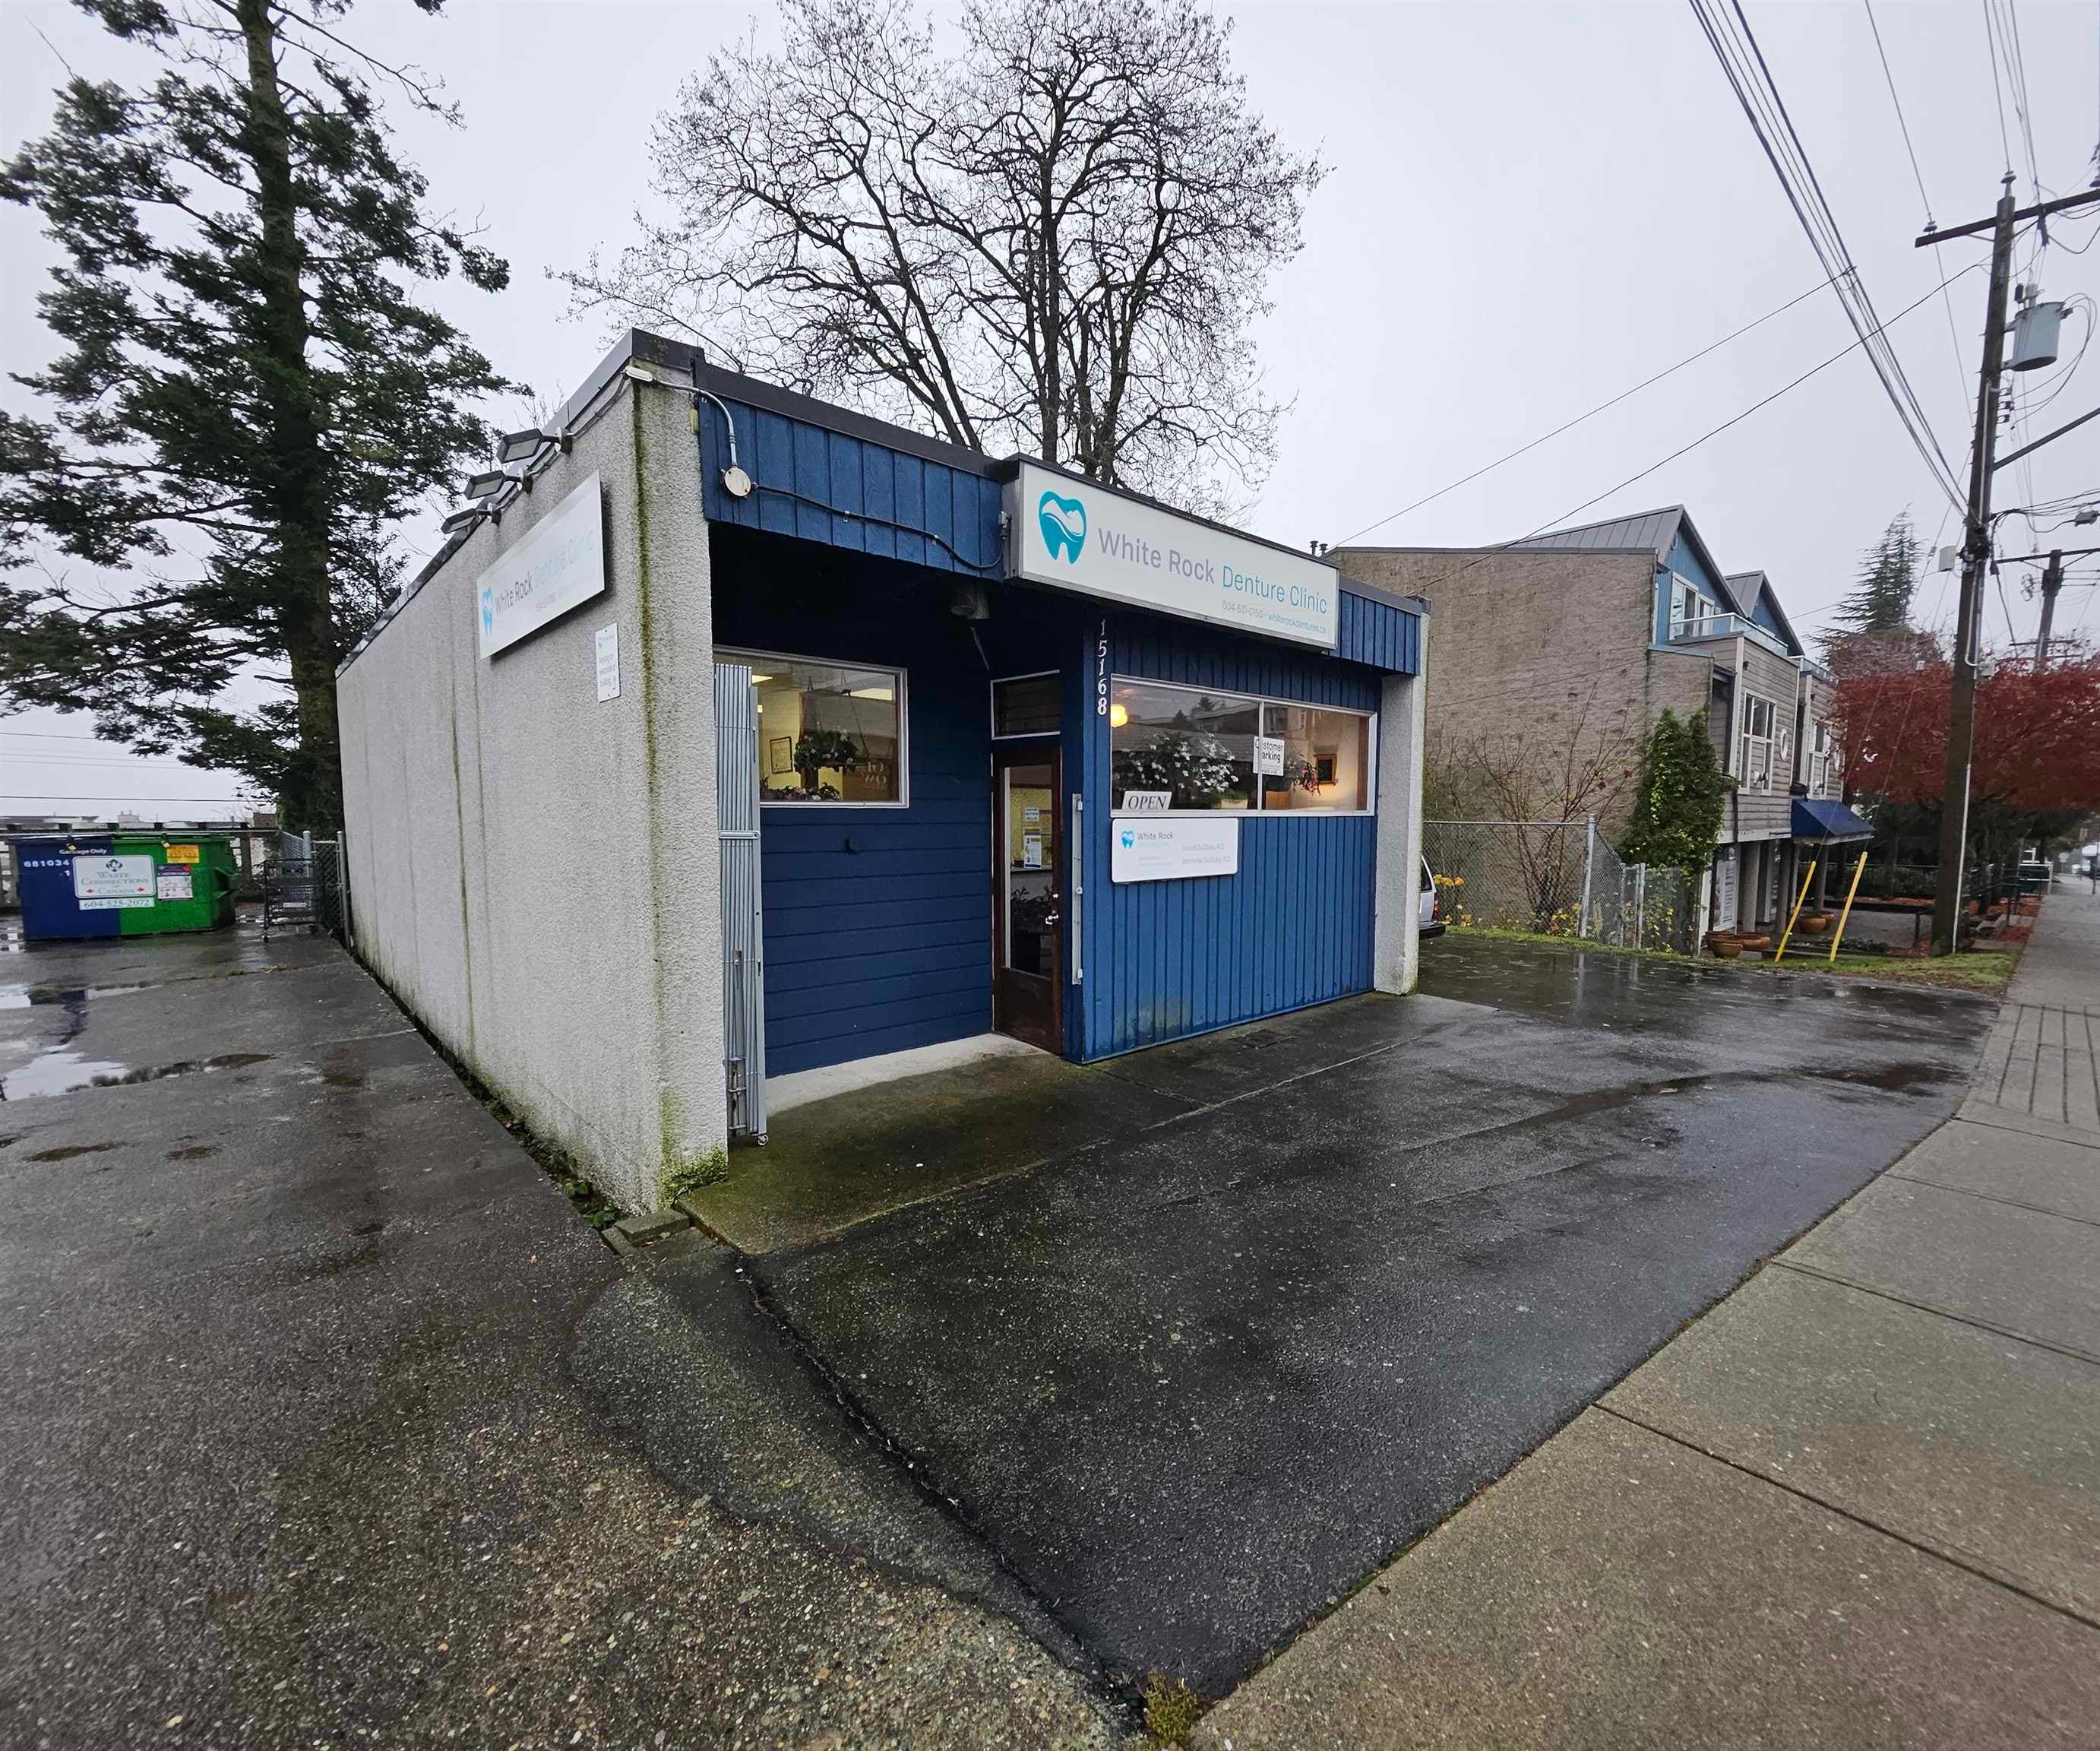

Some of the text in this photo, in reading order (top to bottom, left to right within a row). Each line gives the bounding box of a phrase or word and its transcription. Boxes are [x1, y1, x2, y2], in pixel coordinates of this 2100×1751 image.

[1098, 527, 1327, 614] White Rock Denture Clinic
[495, 589, 514, 616] White
[515, 572, 533, 603] Rock
[1097, 619, 1108, 716] 15168
[1255, 739, 1283, 752] Cstomer
[1261, 751, 1281, 763] arking
[1127, 795, 1168, 810] OPEN
[1137, 831, 1174, 841] White Rock
[24, 860, 70, 868] 681034
[84, 900, 150, 908] 604-525-2072
